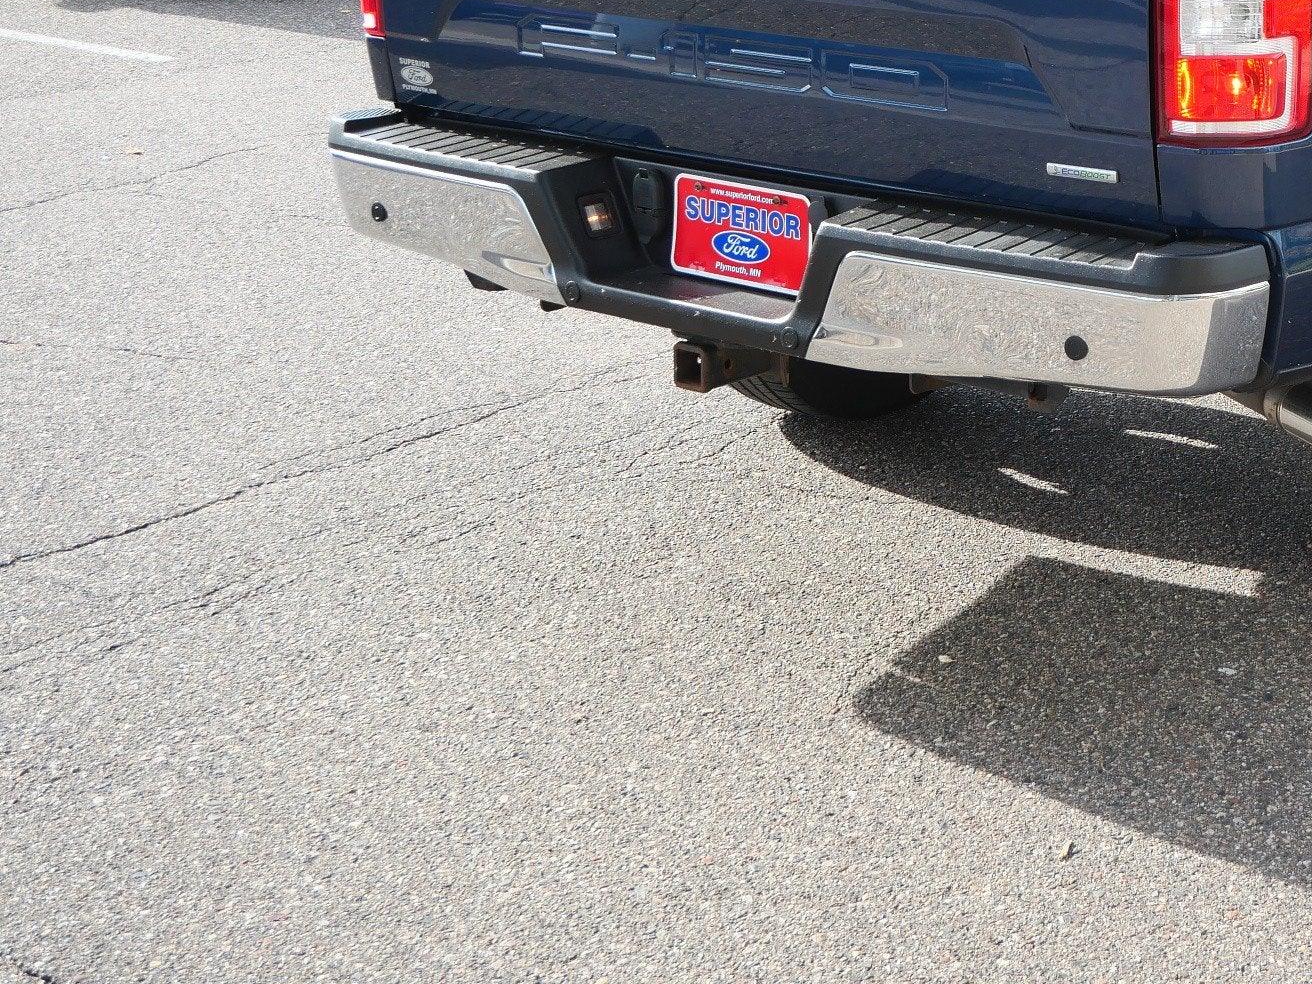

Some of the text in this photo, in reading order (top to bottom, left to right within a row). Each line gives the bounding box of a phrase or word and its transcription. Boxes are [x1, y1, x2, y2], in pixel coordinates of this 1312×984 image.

[399, 57, 430, 68] SUPERIOR
[407, 68, 428, 83] Ford
[684, 195, 801, 241] SUPERIOR
[722, 233, 759, 260] Ford
[715, 261, 762, 278] Plymouth, MN
